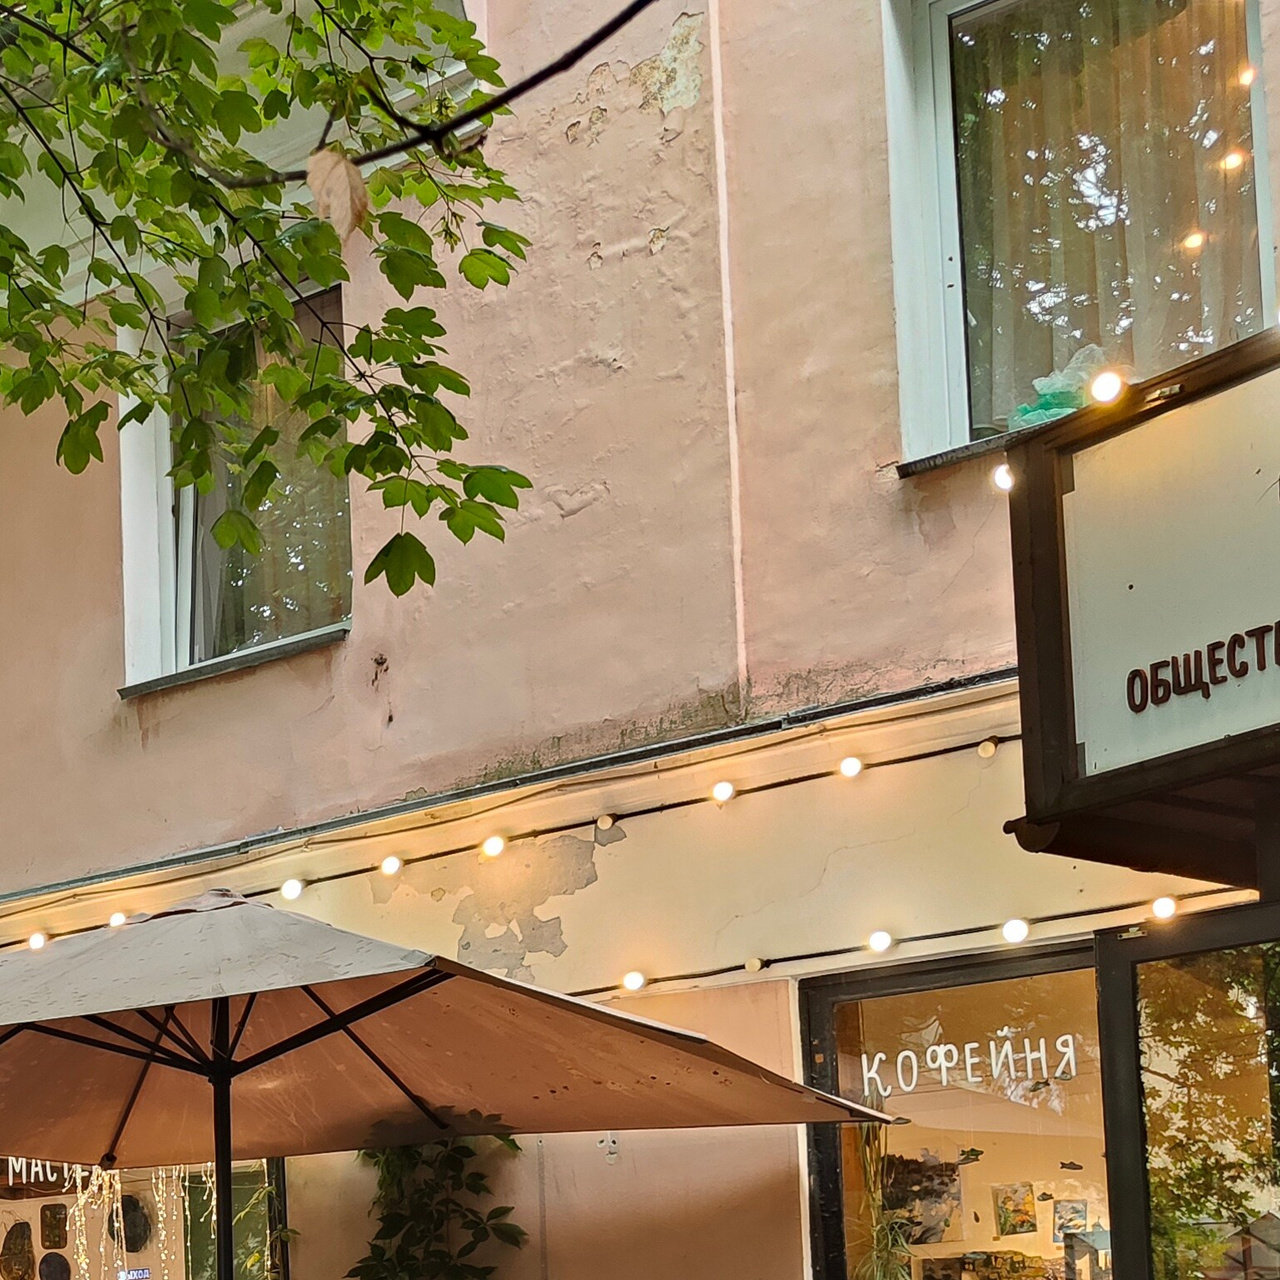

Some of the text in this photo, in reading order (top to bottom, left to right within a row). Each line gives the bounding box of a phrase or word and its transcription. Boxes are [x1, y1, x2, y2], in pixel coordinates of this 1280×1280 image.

[1126, 620, 1280, 714] ОБЩЕСТ
[861, 1025, 1077, 1097] КОФЕЙНЯ
[120, 1269, 149, 1280] ЫХОД
